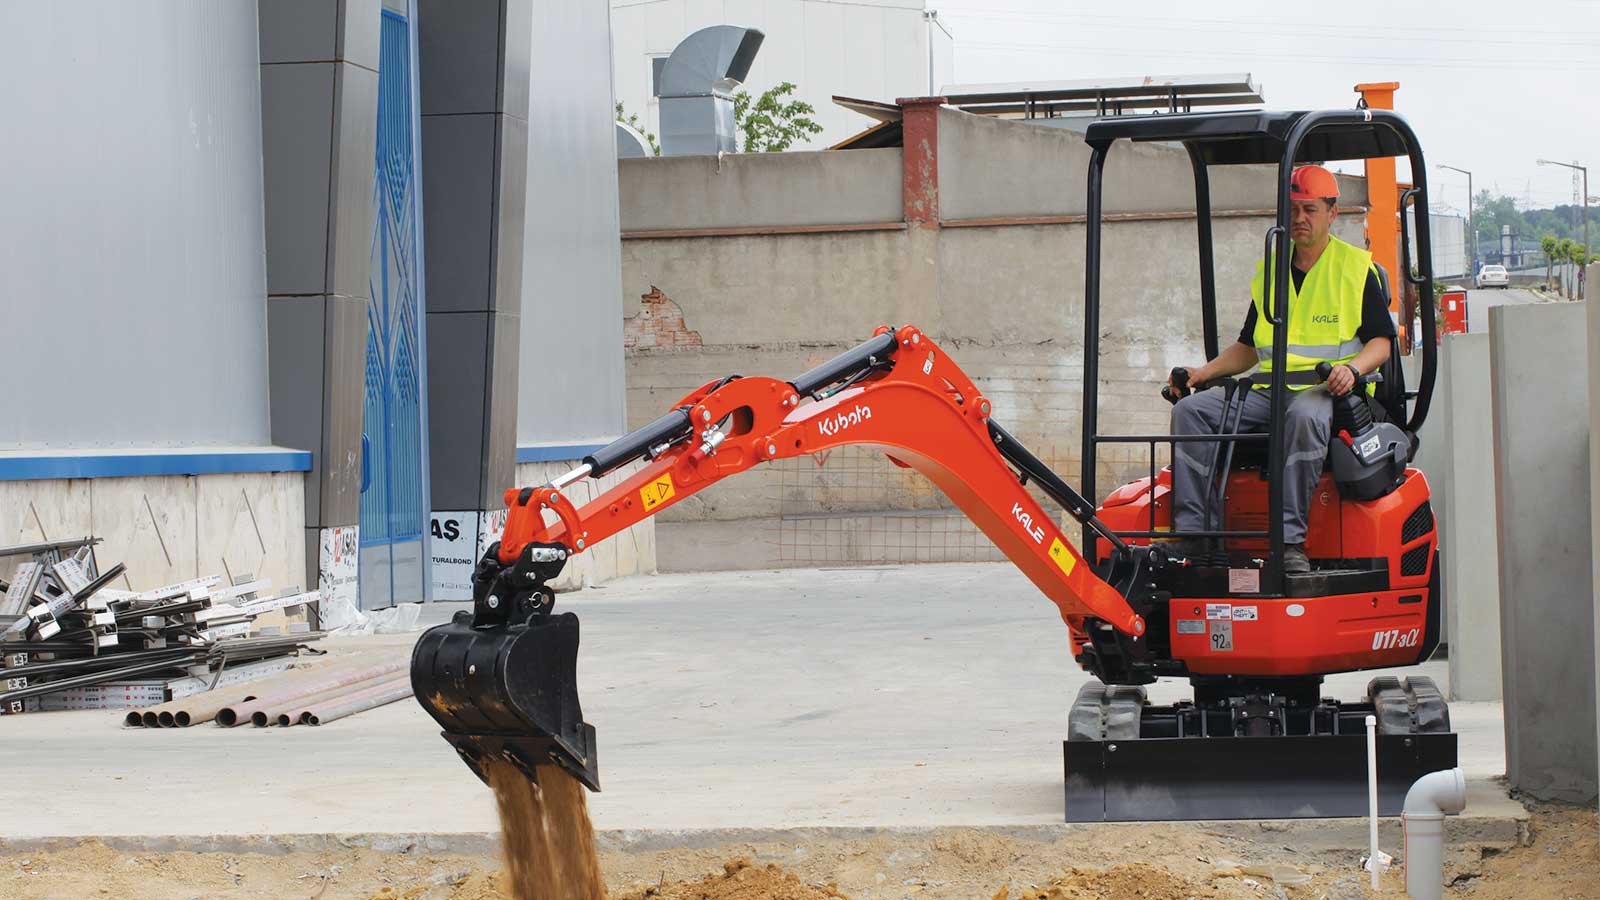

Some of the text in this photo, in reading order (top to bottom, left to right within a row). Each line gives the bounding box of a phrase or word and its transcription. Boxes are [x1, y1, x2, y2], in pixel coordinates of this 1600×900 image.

[1312, 314, 1339, 323] KALE
[818, 405, 872, 436] Kubota
[1011, 502, 1045, 545] KALE
[1212, 633, 1225, 649] 92
